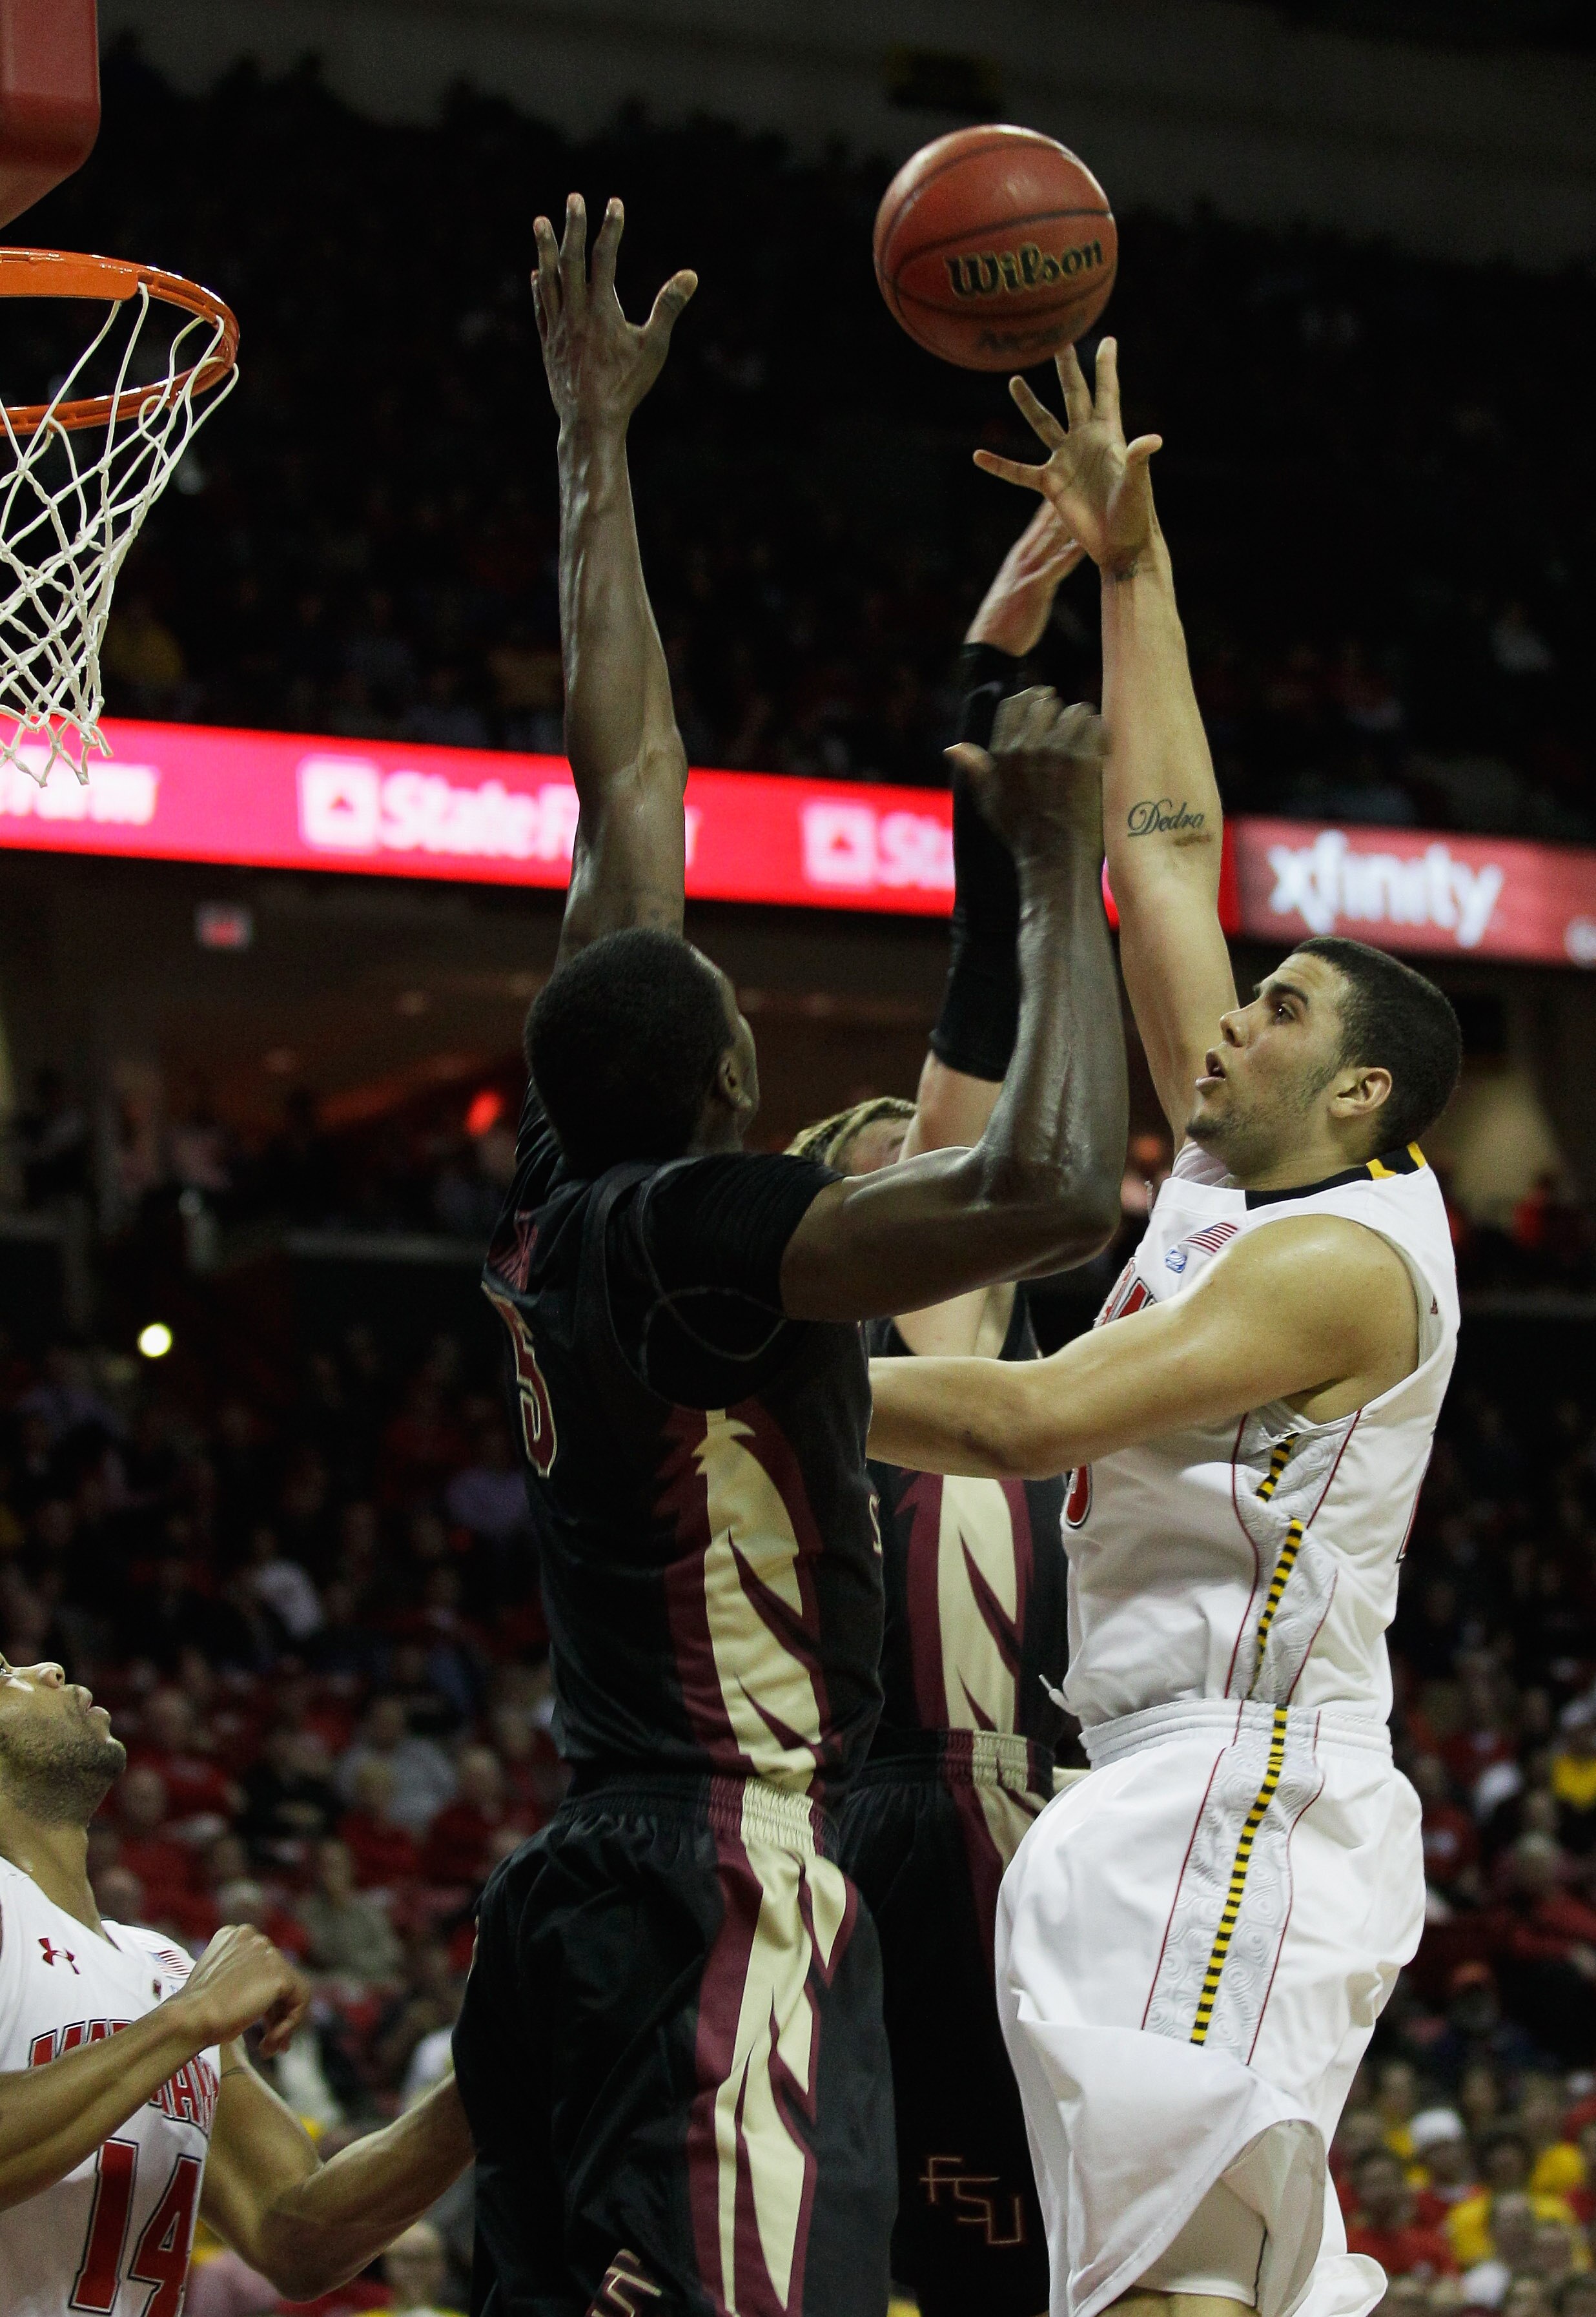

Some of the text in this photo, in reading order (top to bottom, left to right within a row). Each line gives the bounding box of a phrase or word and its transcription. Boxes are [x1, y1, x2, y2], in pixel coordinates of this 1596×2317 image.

[943, 239, 1103, 300] Wilson
[1267, 829, 1504, 948] xfinity
[480, 1280, 558, 1479] 5
[68, 2137, 202, 2317] 14
[919, 2156, 1023, 2245] FSU
